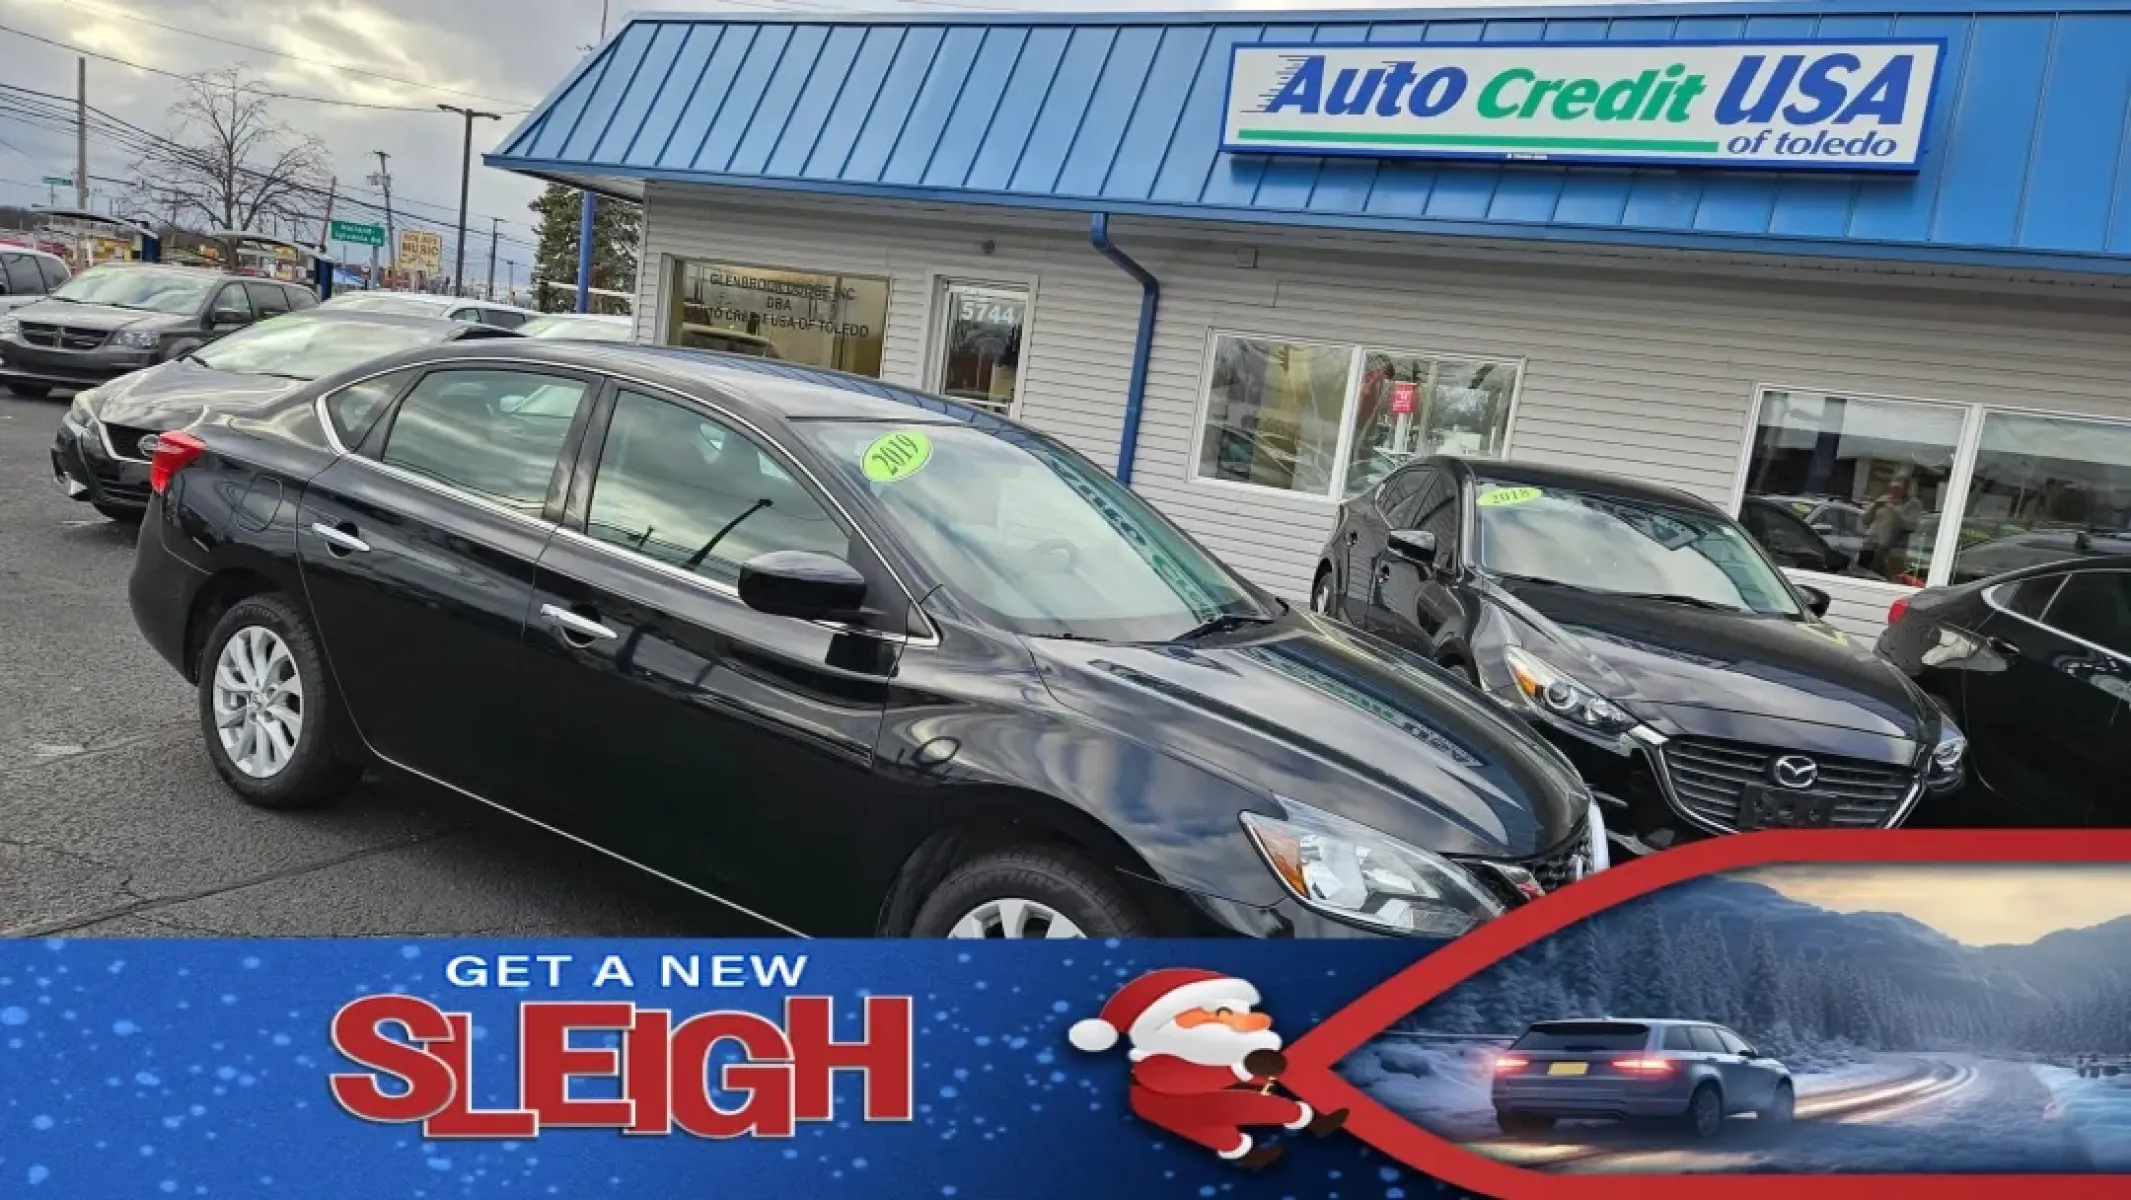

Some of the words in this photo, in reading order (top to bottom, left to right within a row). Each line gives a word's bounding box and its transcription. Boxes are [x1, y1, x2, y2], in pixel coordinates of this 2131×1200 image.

[1255, 54, 1469, 118] Auto
[1476, 63, 1707, 124] Credit
[1713, 53, 1915, 125] USA
[1727, 129, 1773, 155] of
[1775, 129, 1898, 157] toledo
[401, 241, 439, 257] MUSIC
[765, 295, 792, 311] DBA
[960, 300, 1015, 325] 5744
[871, 432, 919, 477] 2019
